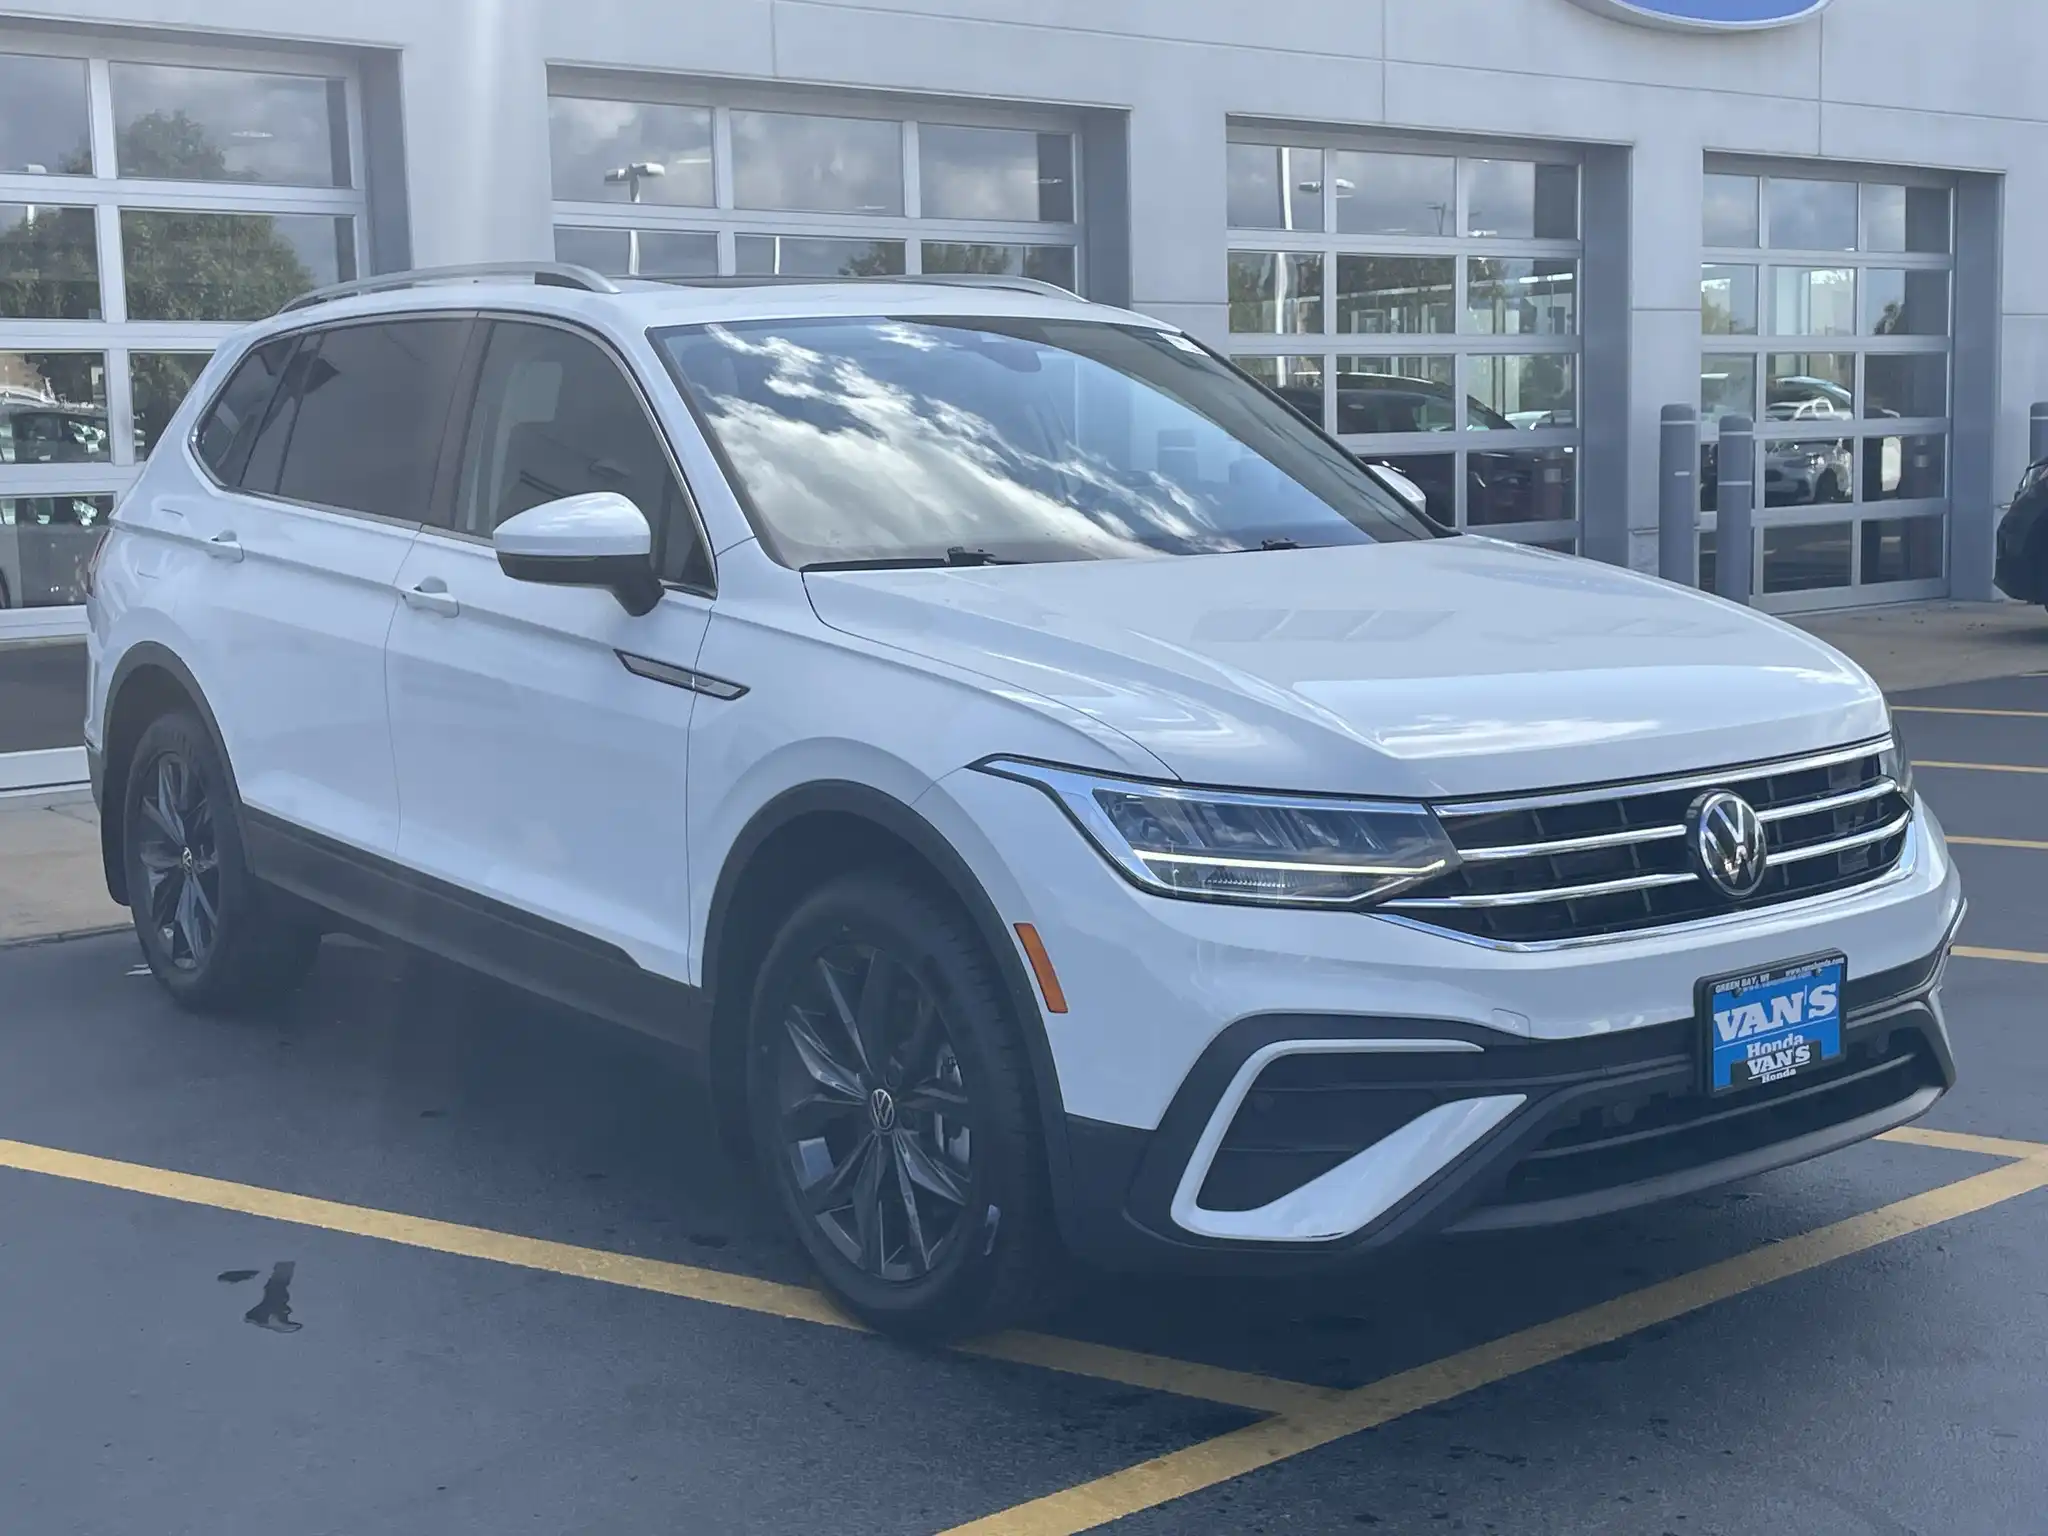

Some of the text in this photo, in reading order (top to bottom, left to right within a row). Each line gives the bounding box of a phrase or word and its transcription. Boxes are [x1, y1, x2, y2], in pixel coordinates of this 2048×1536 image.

[1715, 979, 1740, 993] GREEN
[1747, 1033, 1804, 1058] Honda
[1762, 1067, 1797, 1084] Honda
